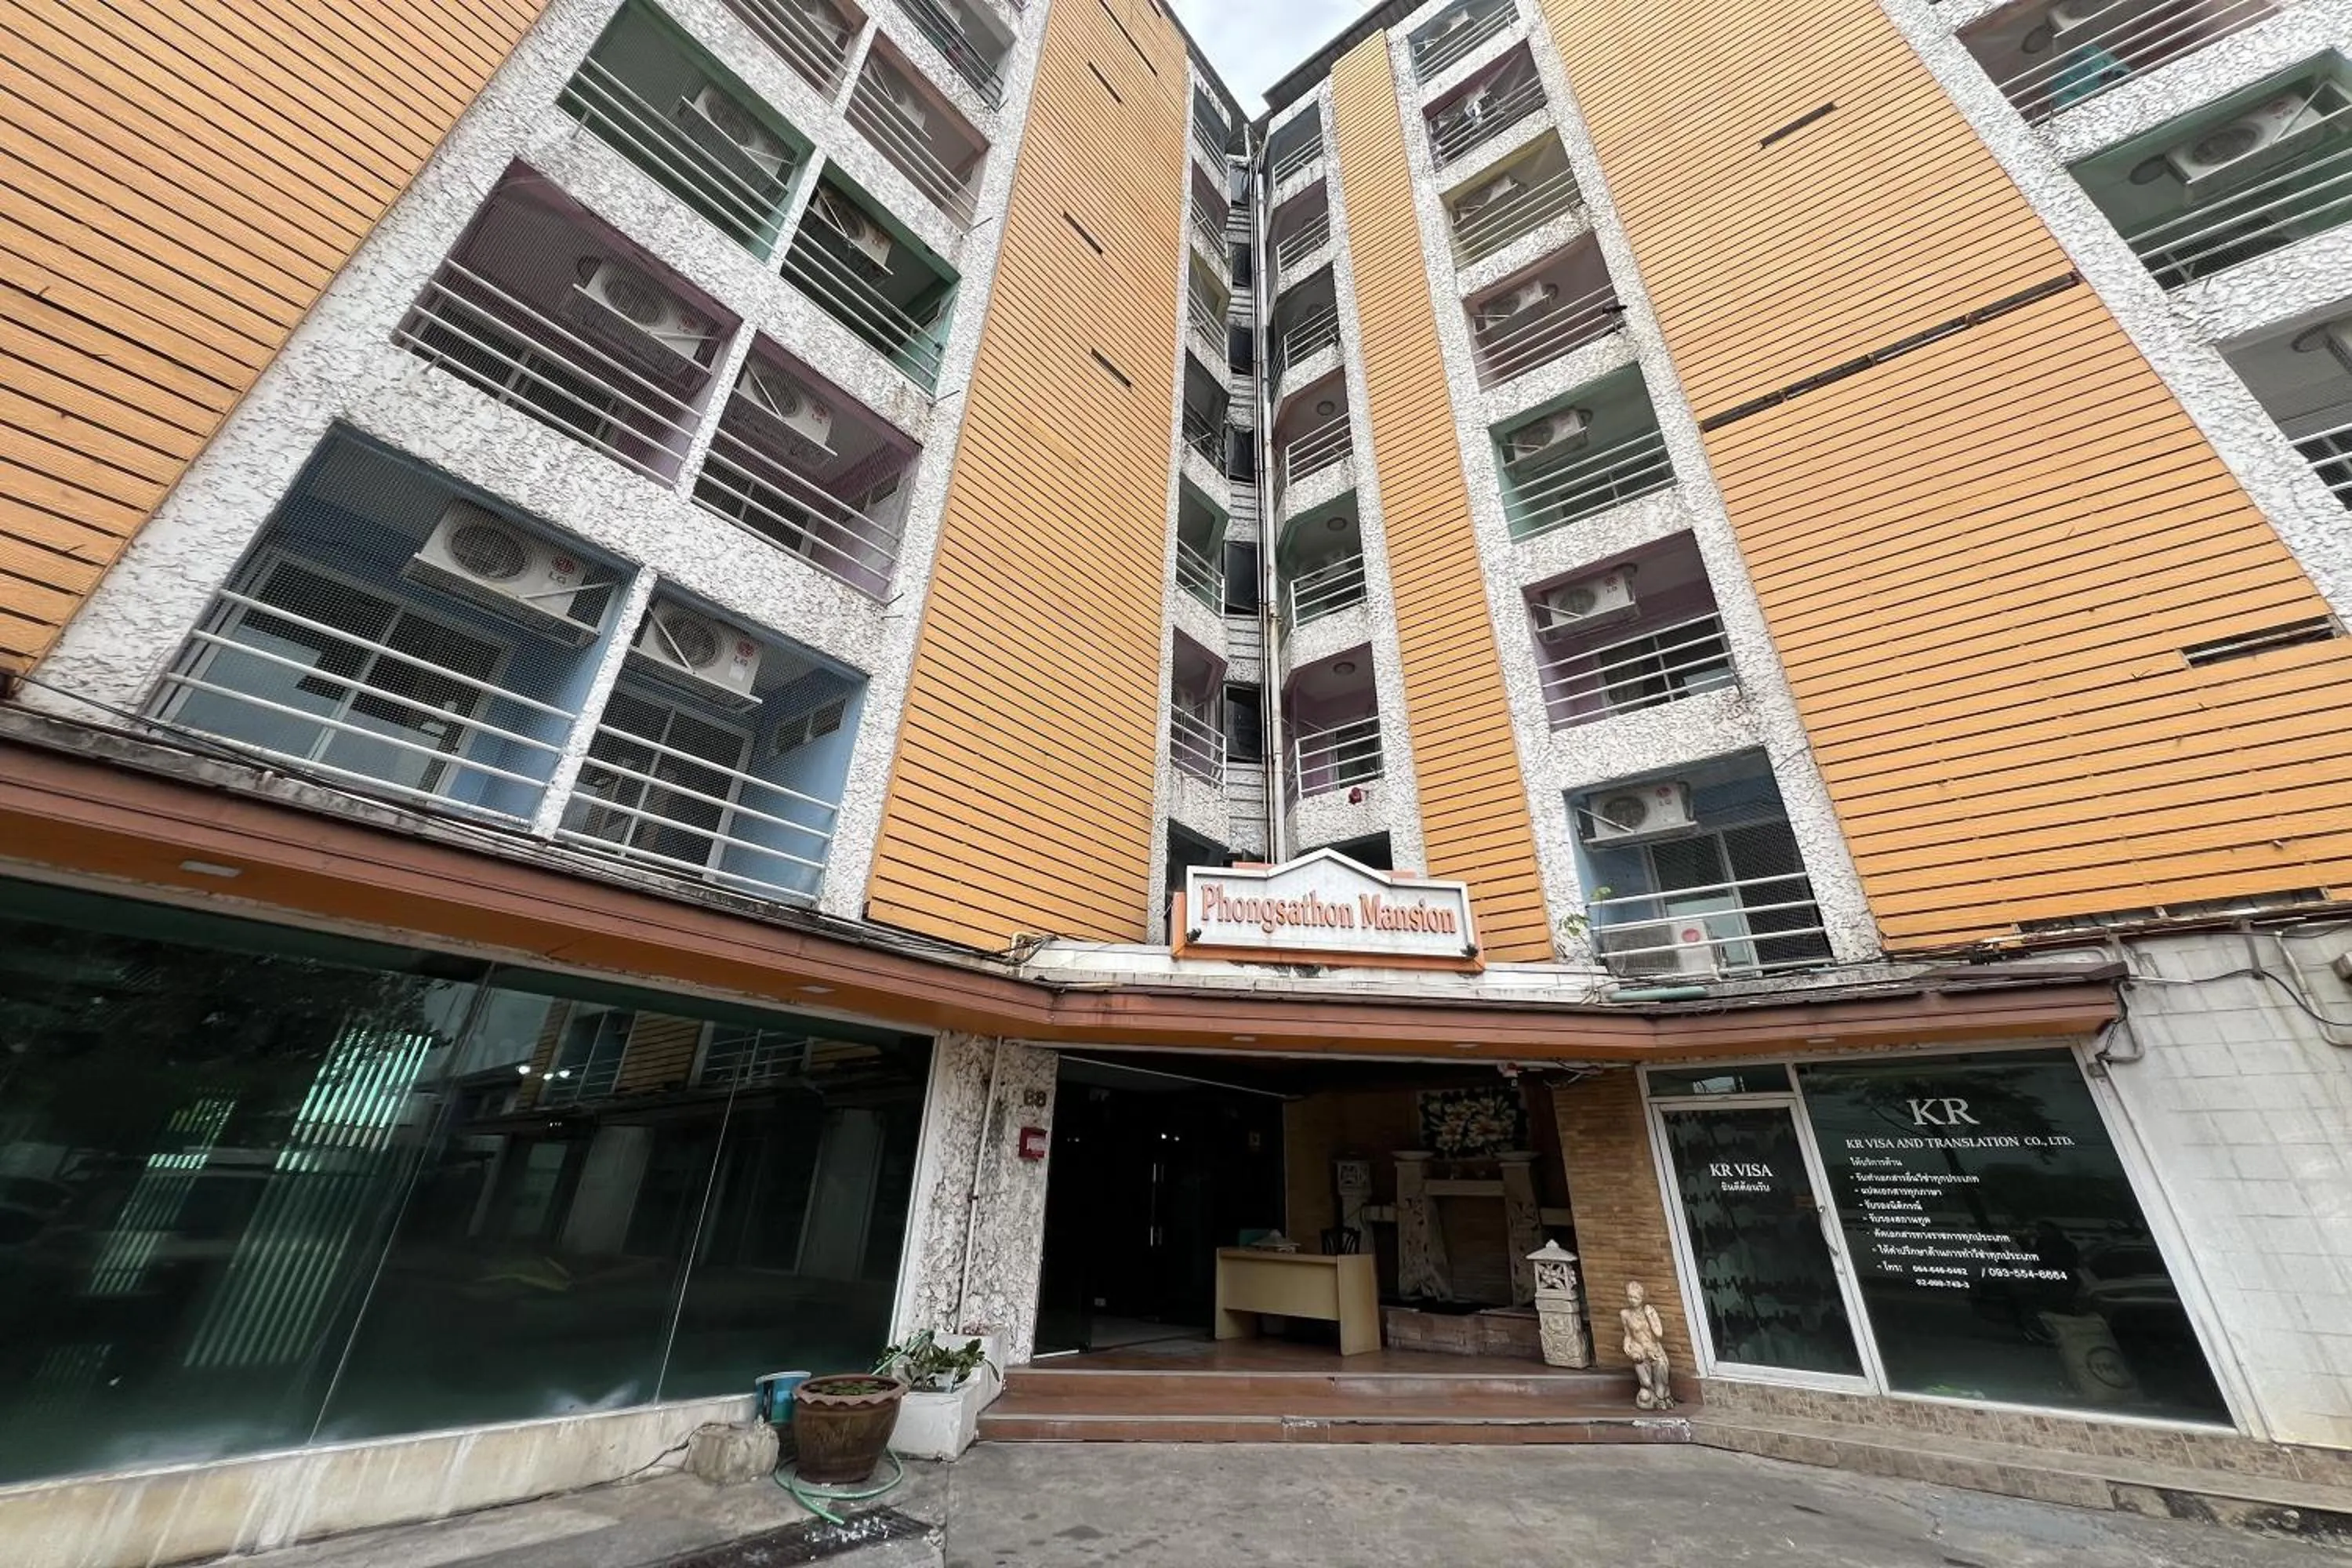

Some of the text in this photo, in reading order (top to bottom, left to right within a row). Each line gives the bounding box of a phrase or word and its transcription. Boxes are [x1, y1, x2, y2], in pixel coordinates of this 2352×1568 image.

[1200, 884, 1457, 934] Phongsathon Mansion
[1907, 1098, 1980, 1125] KR
[1846, 1138, 1864, 1149] KR
[1865, 1138, 1894, 1149] VISA
[1896, 1138, 1922, 1149] AND
[1926, 1137, 2020, 1148] TRANSLATION
[2048, 1136, 2075, 1146] LTD.
[1710, 1163, 1773, 1176] KR VISA
